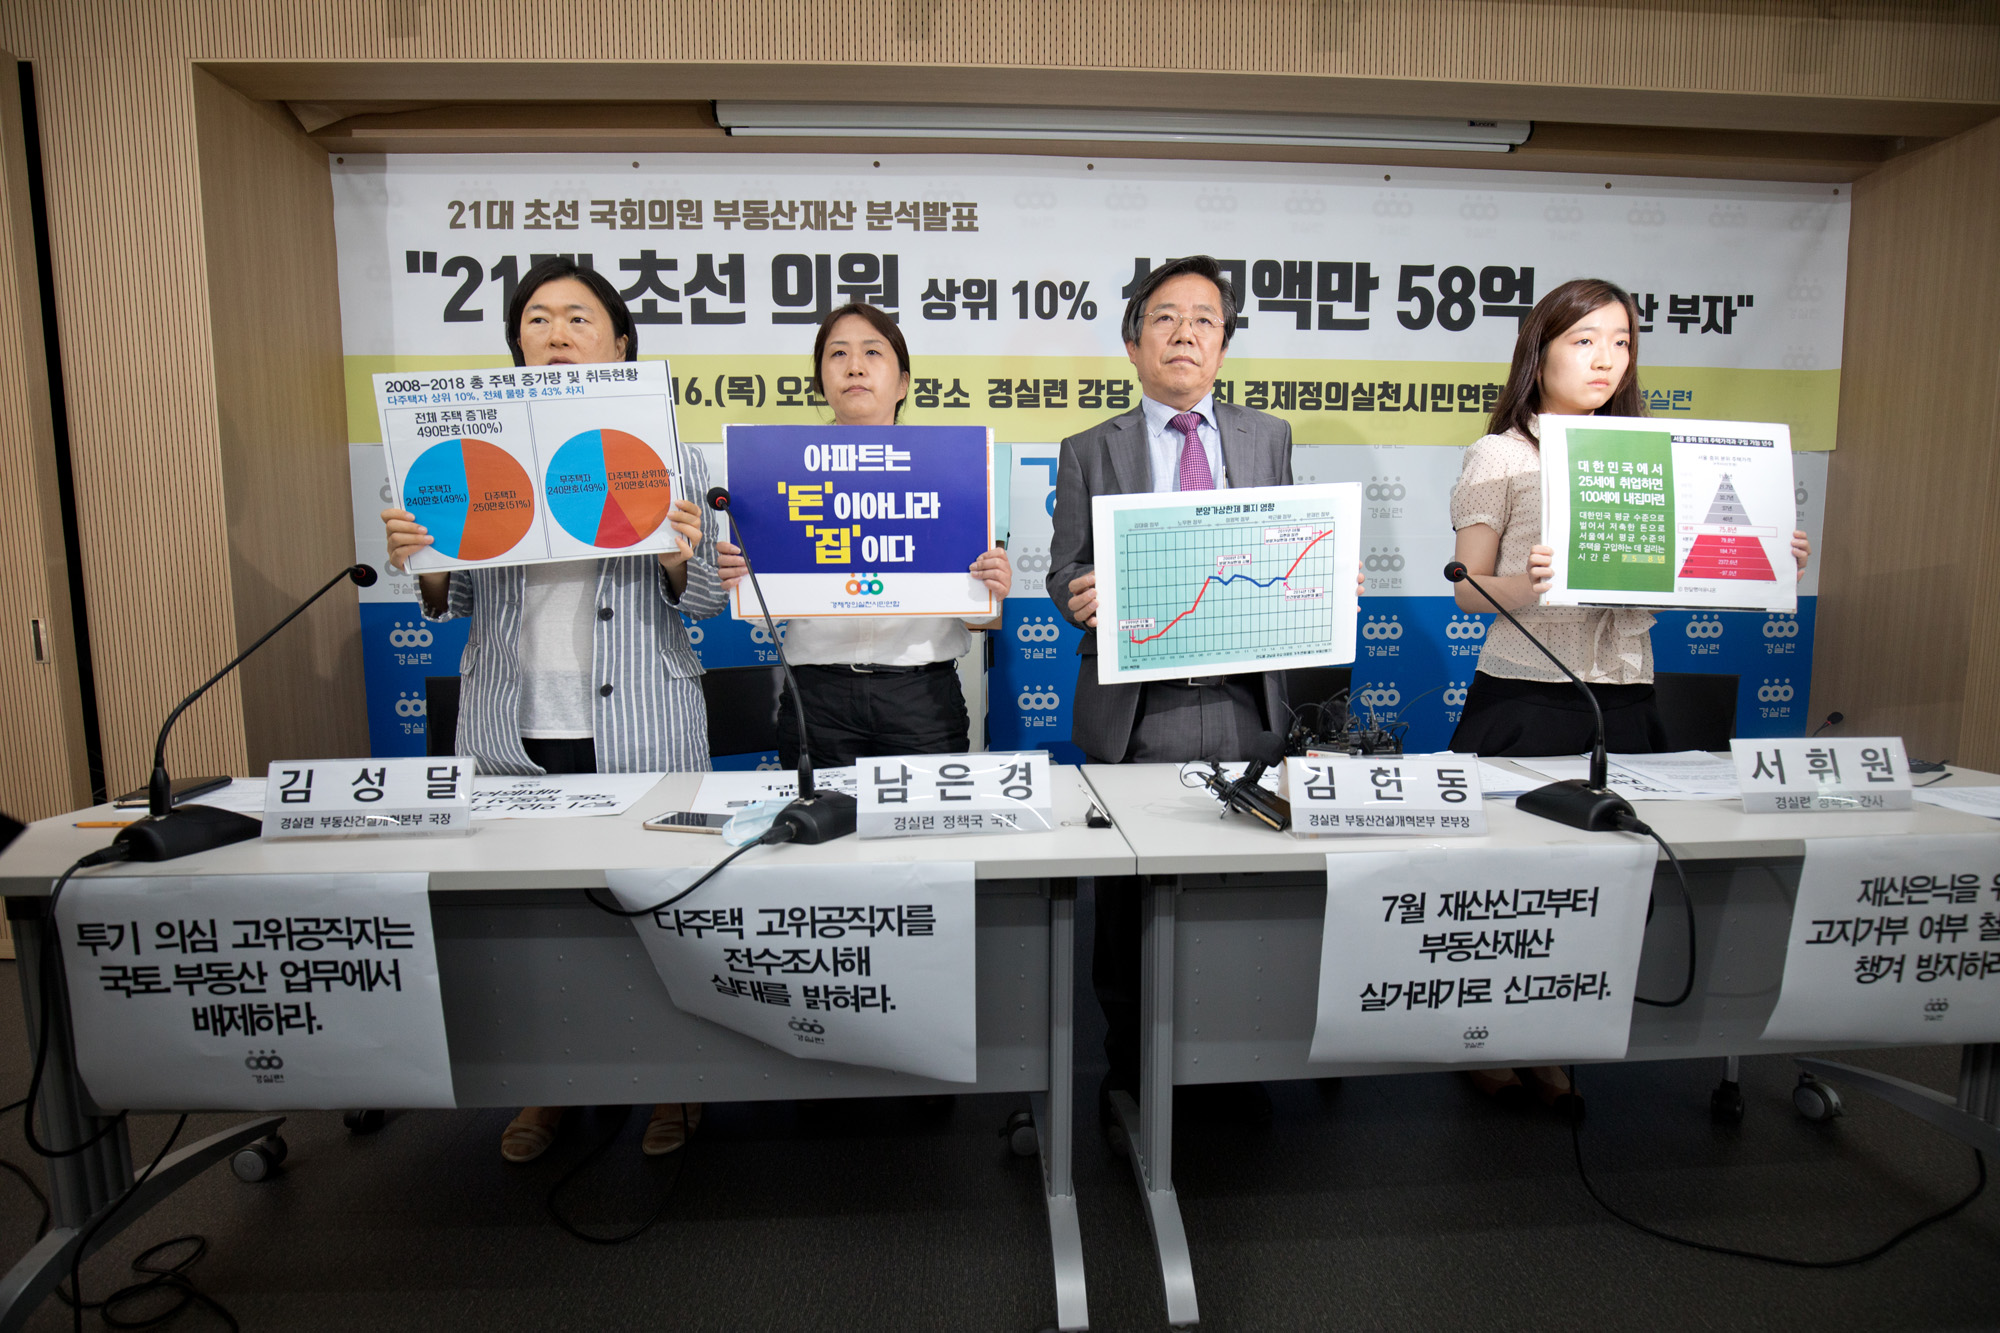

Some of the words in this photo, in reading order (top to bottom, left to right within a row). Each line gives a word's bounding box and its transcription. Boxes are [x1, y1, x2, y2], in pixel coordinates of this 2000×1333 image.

[447, 200, 514, 229] 21대
[523, 199, 579, 230] 초선
[590, 198, 703, 230] 국회의원
[713, 200, 857, 230] 부동산재산
[866, 201, 979, 232] 분석발표
[619, 250, 746, 324] 초선
[771, 253, 900, 324] 의원
[921, 278, 997, 320] 상위
[1012, 280, 1097, 321] 10%
[1396, 264, 1535, 334] 58억
[1667, 294, 1754, 334] 부자"
[469, 375, 484, 390] 총
[489, 374, 515, 388] 주택
[521, 371, 562, 387] 증가량
[567, 370, 580, 384] 및
[586, 368, 639, 383] 취득현황
[387, 393, 428, 406] 다주택자
[431, 392, 451, 403] 상위
[483, 390, 503, 401] 전체
[506, 389, 525, 399] 물량
[528, 388, 538, 398] 중
[541, 386, 562, 397] 43%
[565, 385, 585, 396] 차지
[914, 378, 970, 408] 장소
[988, 378, 1068, 408] 경실련
[1078, 378, 1133, 409] 강당
[1245, 380, 1504, 413] 경제정의실천시민연합
[415, 411, 437, 425] 전체
[440, 410, 462, 422] 주택
[465, 408, 498, 422] 증가량
[417, 422, 503, 438] 490만호(100%)
[803, 444, 911, 471] 아파트는
[608, 470, 639, 481] 다주택자
[1577, 460, 1663, 476] 대한민국에서
[559, 473, 591, 483] 무주택자
[614, 479, 670, 491] 210만호(43%)
[1578, 475, 1615, 489] 25세에
[1619, 476, 1663, 491] 취업하면
[418, 484, 452, 495] 무주택자
[484, 490, 517, 501] 다주택자
[547, 483, 606, 495] 240만호(49%)
[406, 494, 467, 507] 240만호(49%)
[473, 499, 531, 512] 250만호(51%)
[1580, 490, 1620, 504] 100세에
[1623, 492, 1665, 506] 내집마련
[1195, 504, 1241, 516] 분양가상한제
[1243, 503, 1258, 513] 폐지
[1260, 503, 1275, 512] 영향
[1367, 507, 1403, 519] 경실련
[1579, 511, 1611, 520] 대한민국
[1614, 512, 1630, 521] 평균
[1633, 513, 1665, 522] 수준으로
[1579, 521, 1605, 531] 벌어서
[1640, 523, 1665, 532] 돈으로
[1579, 532, 1614, 541] 서울에서
[1619, 533, 1635, 542] 평균
[1640, 534, 1665, 543] 수준의
[1578, 542, 1601, 552] 주택을
[1603, 543, 1632, 553] 구입하는
[1644, 544, 1665, 553] 걸리는
[1366, 577, 1402, 589] 경실련
[1020, 647, 1057, 660] 경실련
[1364, 645, 1400, 657] 경실련
[1447, 644, 1482, 657] 경실련
[1687, 643, 1720, 655] 경실련
[1763, 642, 1796, 655] 경실련
[394, 653, 432, 666] 경실련
[1758, 706, 1791, 718] 경실련
[1020, 715, 1057, 728] 경실련
[1775, 796, 1811, 809] 경실련
[1860, 795, 1884, 808] 간사
[280, 816, 315, 830] 경실련
[428, 812, 451, 825] 국장
[893, 815, 935, 831] 경실련
[943, 814, 984, 829] 정책국
[990, 813, 1018, 828] 국장
[1308, 814, 1340, 827] 경실련
[1345, 814, 1436, 828] 부동산건설개혁본부
[1440, 815, 1470, 829] 본부장
[1856, 873, 1981, 908] 재산은닉을
[1382, 891, 1427, 925] 7월
[1437, 886, 1600, 922] 재산신고부터
[652, 906, 744, 940] 다주택
[756, 904, 937, 939] 고위공직자를
[76, 920, 141, 957] 투기
[155, 918, 219, 954] 의심
[232, 915, 415, 952] 고위공직자는
[1805, 914, 1909, 947] 고지거부
[1919, 913, 1969, 944] 여부
[1419, 927, 1555, 964] 부동산재산
[723, 945, 871, 977] 전수조사해
[1854, 952, 1906, 985] 챙겨
[279, 958, 402, 993] 업무에서
[710, 973, 792, 1008] 실태를
[802, 983, 896, 1013] 밝혀라.
[1359, 977, 1493, 1012] 실거래가로
[1503, 970, 1612, 1005] 신고하라.
[191, 1001, 323, 1037] 배제하라.
